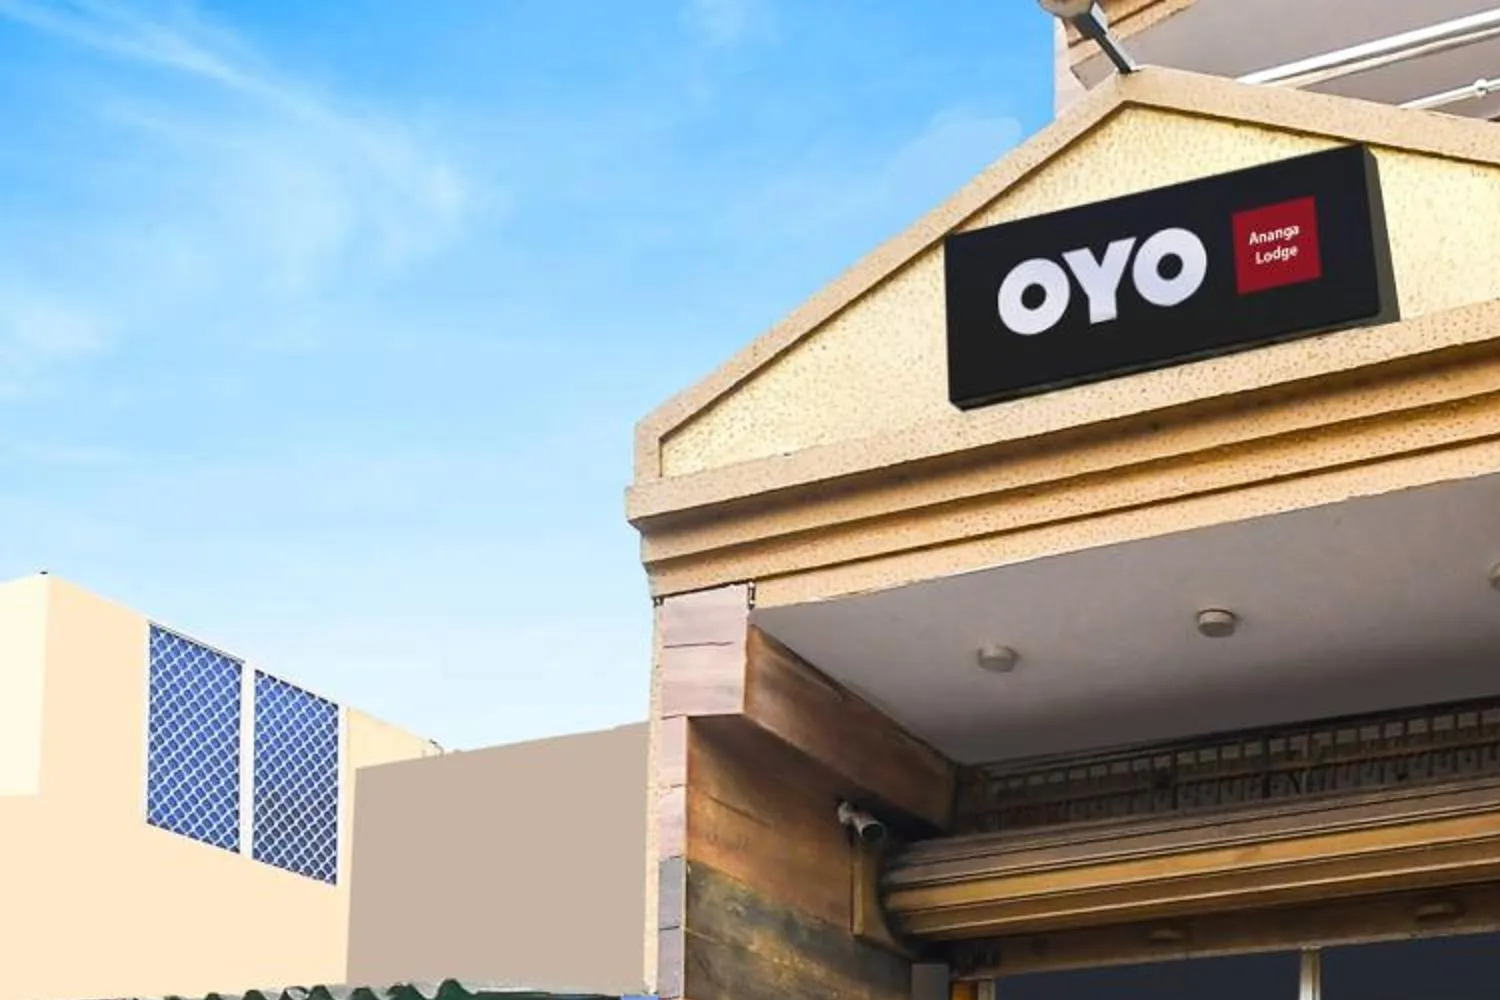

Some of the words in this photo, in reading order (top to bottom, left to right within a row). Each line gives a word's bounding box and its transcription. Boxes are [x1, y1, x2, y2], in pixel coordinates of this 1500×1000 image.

[1248, 225, 1299, 245] Ananga
[1255, 245, 1298, 264] Lodge
[998, 228, 1207, 335] OYO
